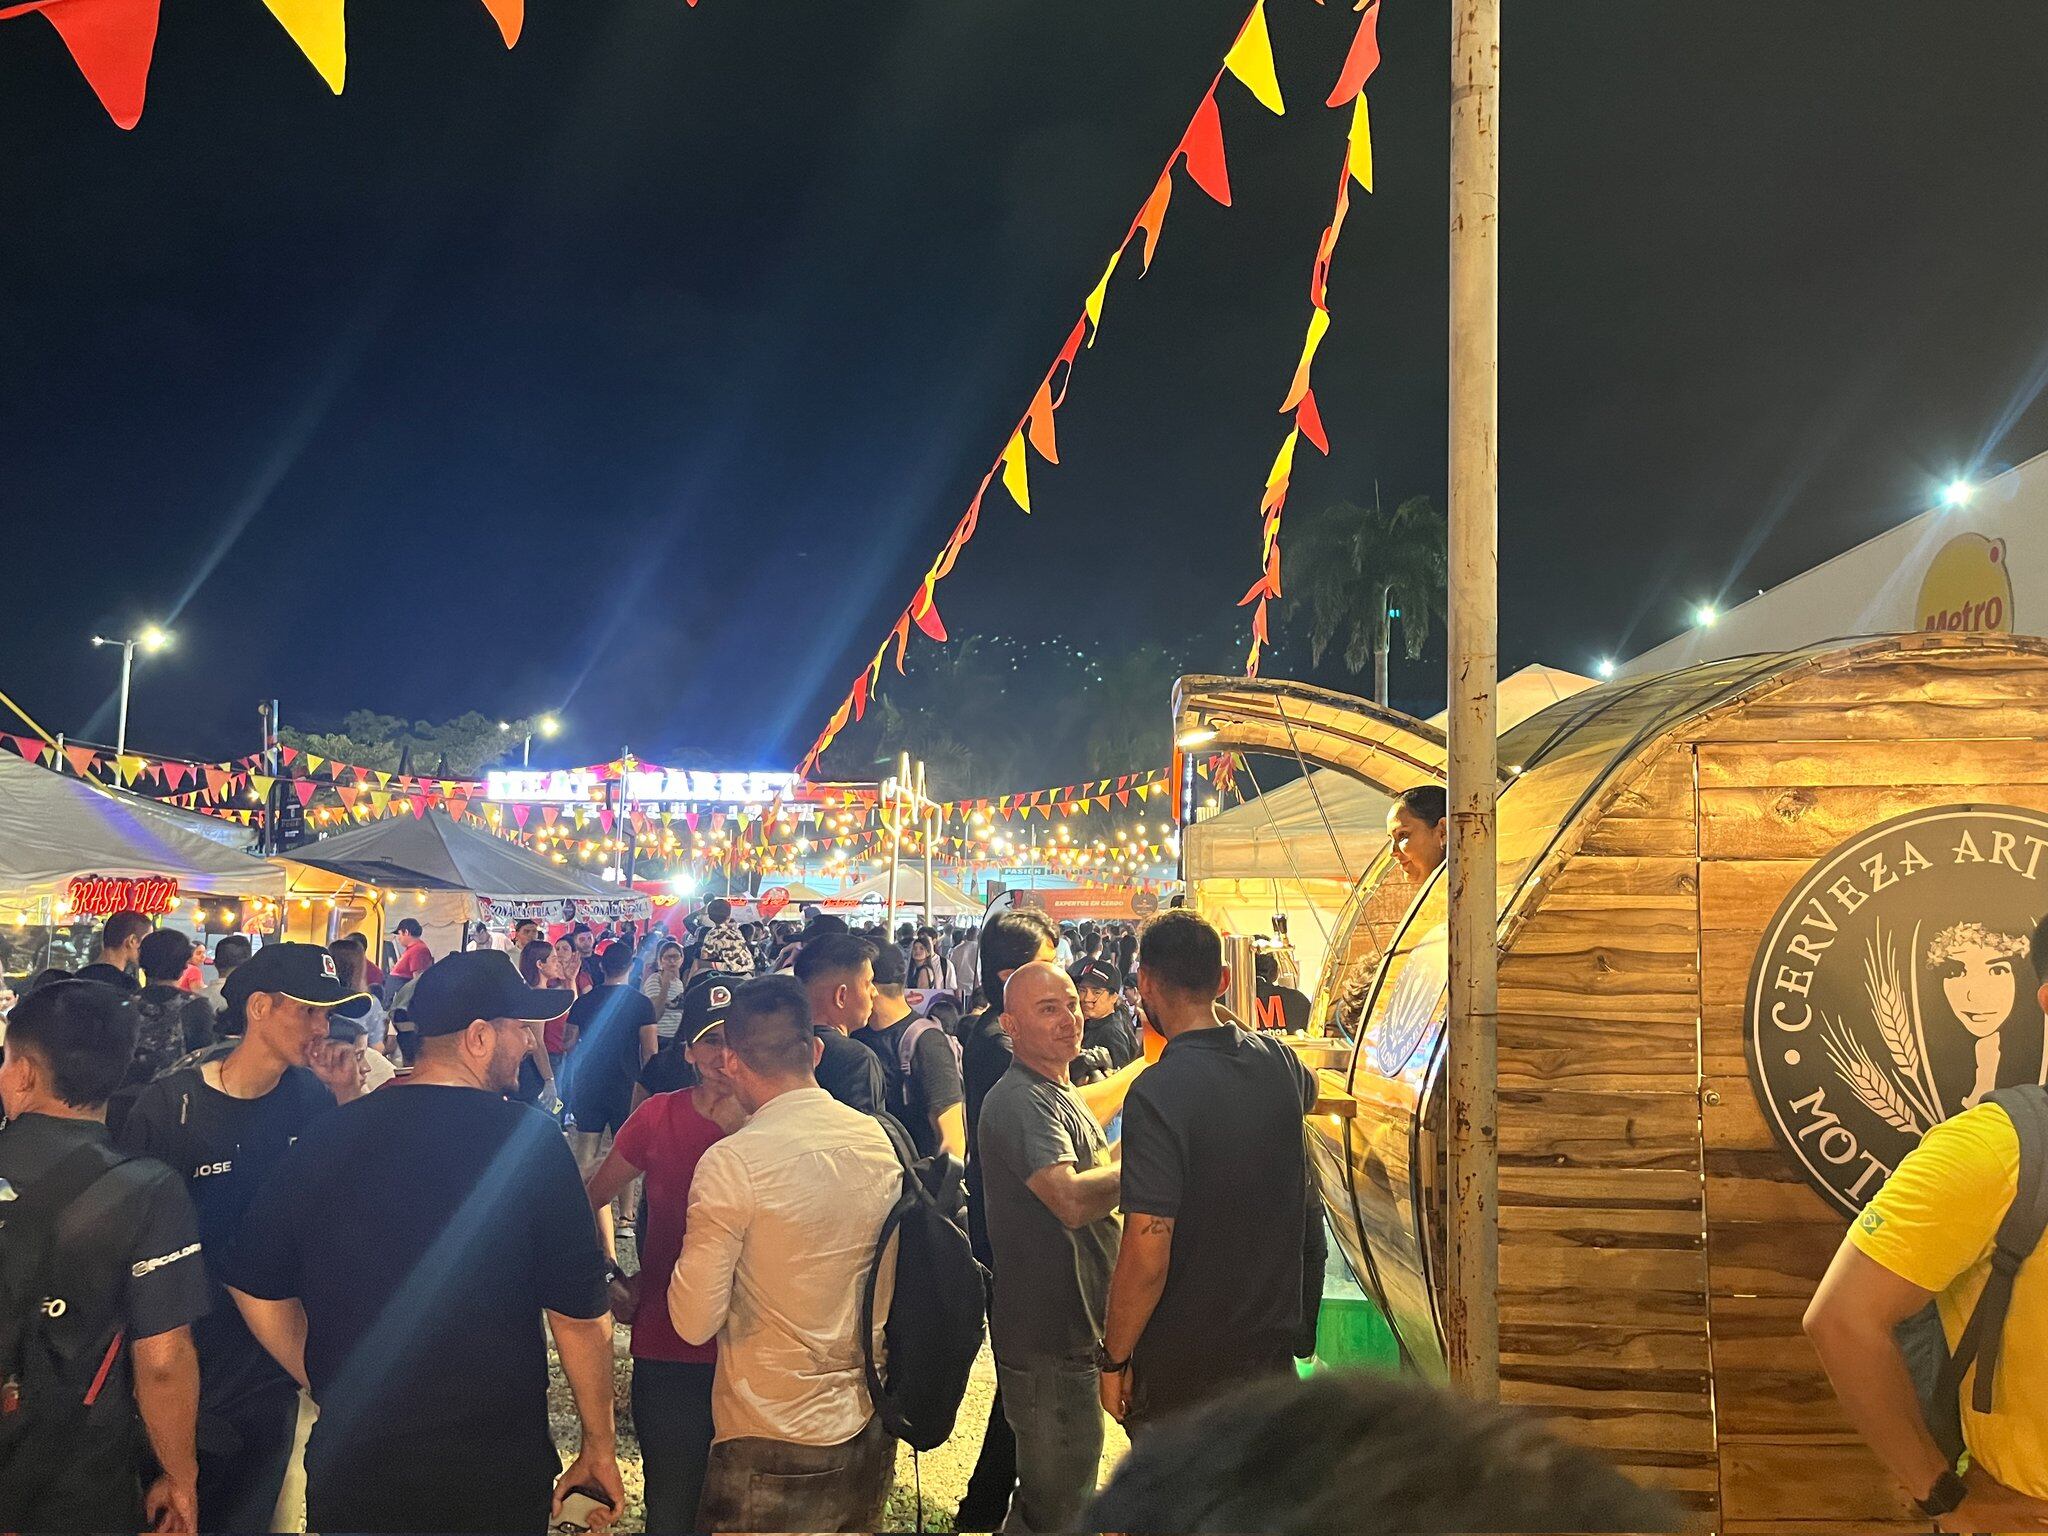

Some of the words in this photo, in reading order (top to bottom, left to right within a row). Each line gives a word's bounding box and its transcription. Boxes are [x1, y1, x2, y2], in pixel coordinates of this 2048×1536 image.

[1925, 596, 2003, 632] Metro
[70, 881, 132, 914] BRASAS
[132, 881, 178, 913] PIZZA
[1771, 840, 1934, 1032] CERVEZA
[1789, 1086, 1893, 1201] MOT
[193, 1160, 232, 1178] JOSE
